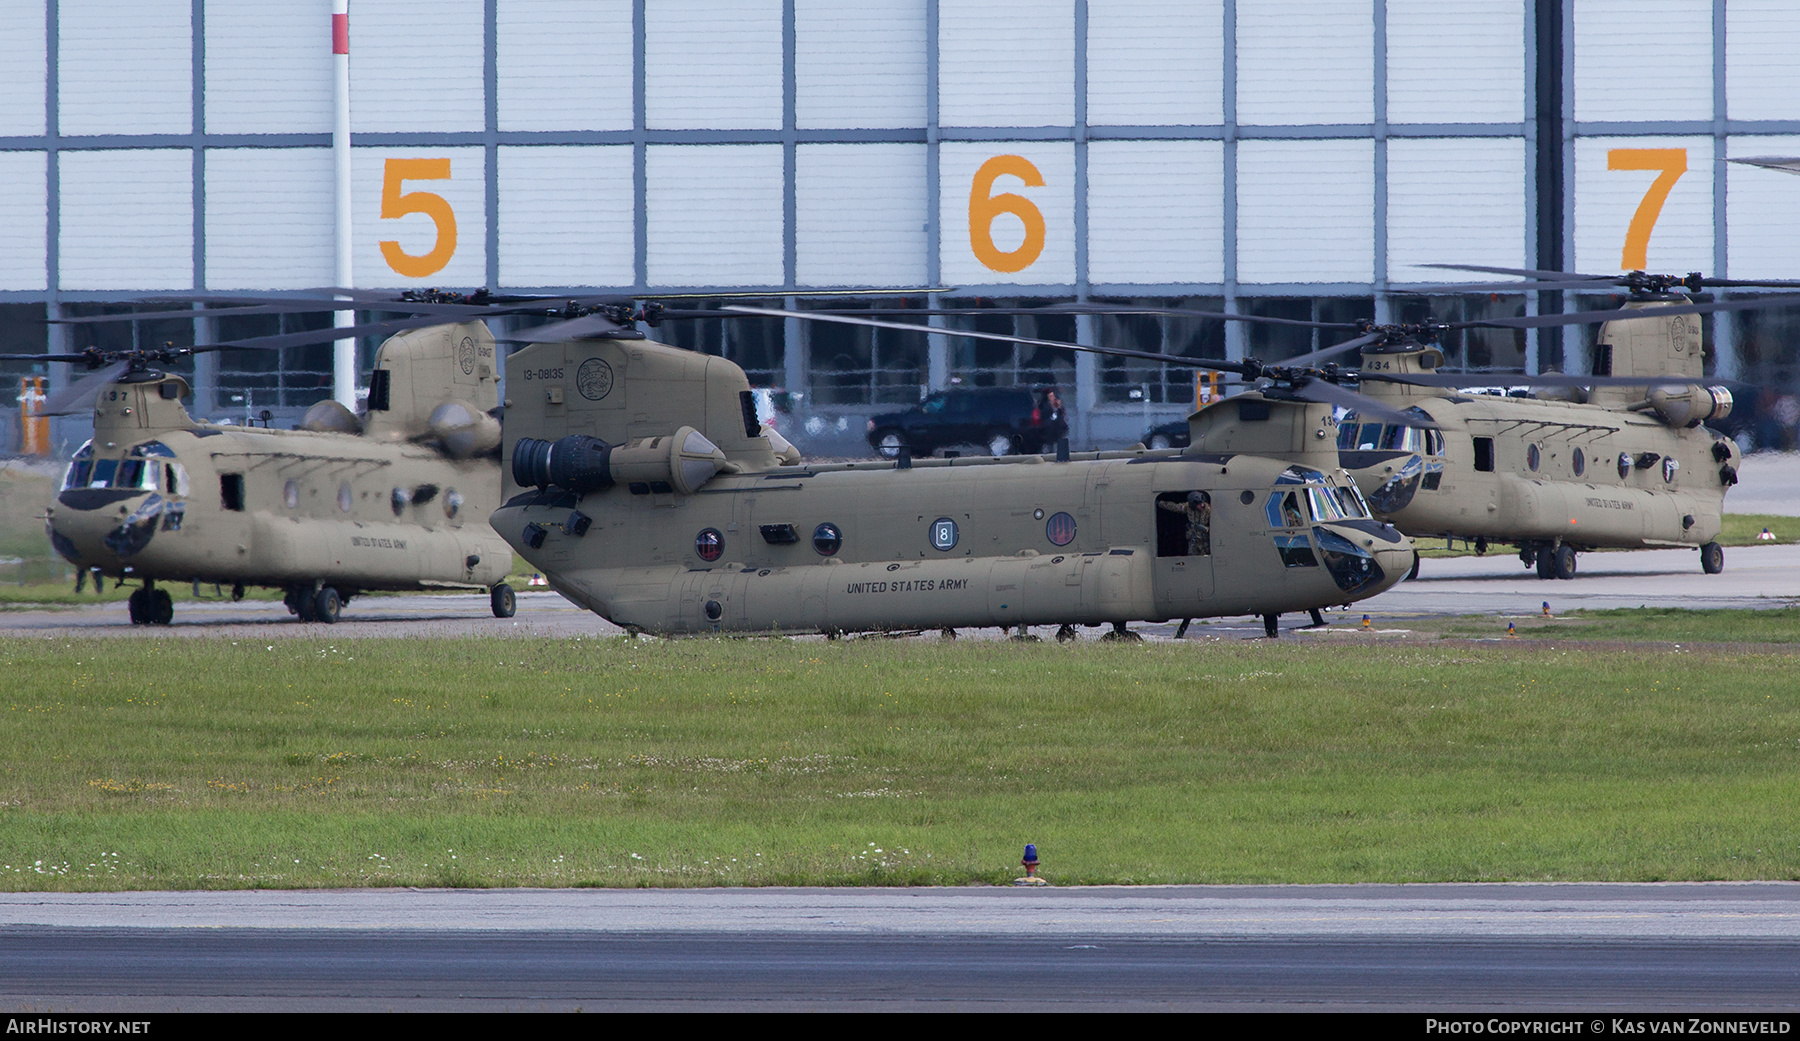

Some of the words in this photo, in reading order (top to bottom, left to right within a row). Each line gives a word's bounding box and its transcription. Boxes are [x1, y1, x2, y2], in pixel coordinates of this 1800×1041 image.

[969, 155, 1045, 272] 6
[1608, 149, 1687, 270] 7
[380, 159, 457, 277] 5
[1368, 361, 1390, 370] 434
[523, 368, 564, 380] 13-08135
[940, 528, 948, 540] 8
[847, 582, 887, 594] UNITED
[890, 580, 935, 592] STATES
[938, 579, 968, 590] ARMY
